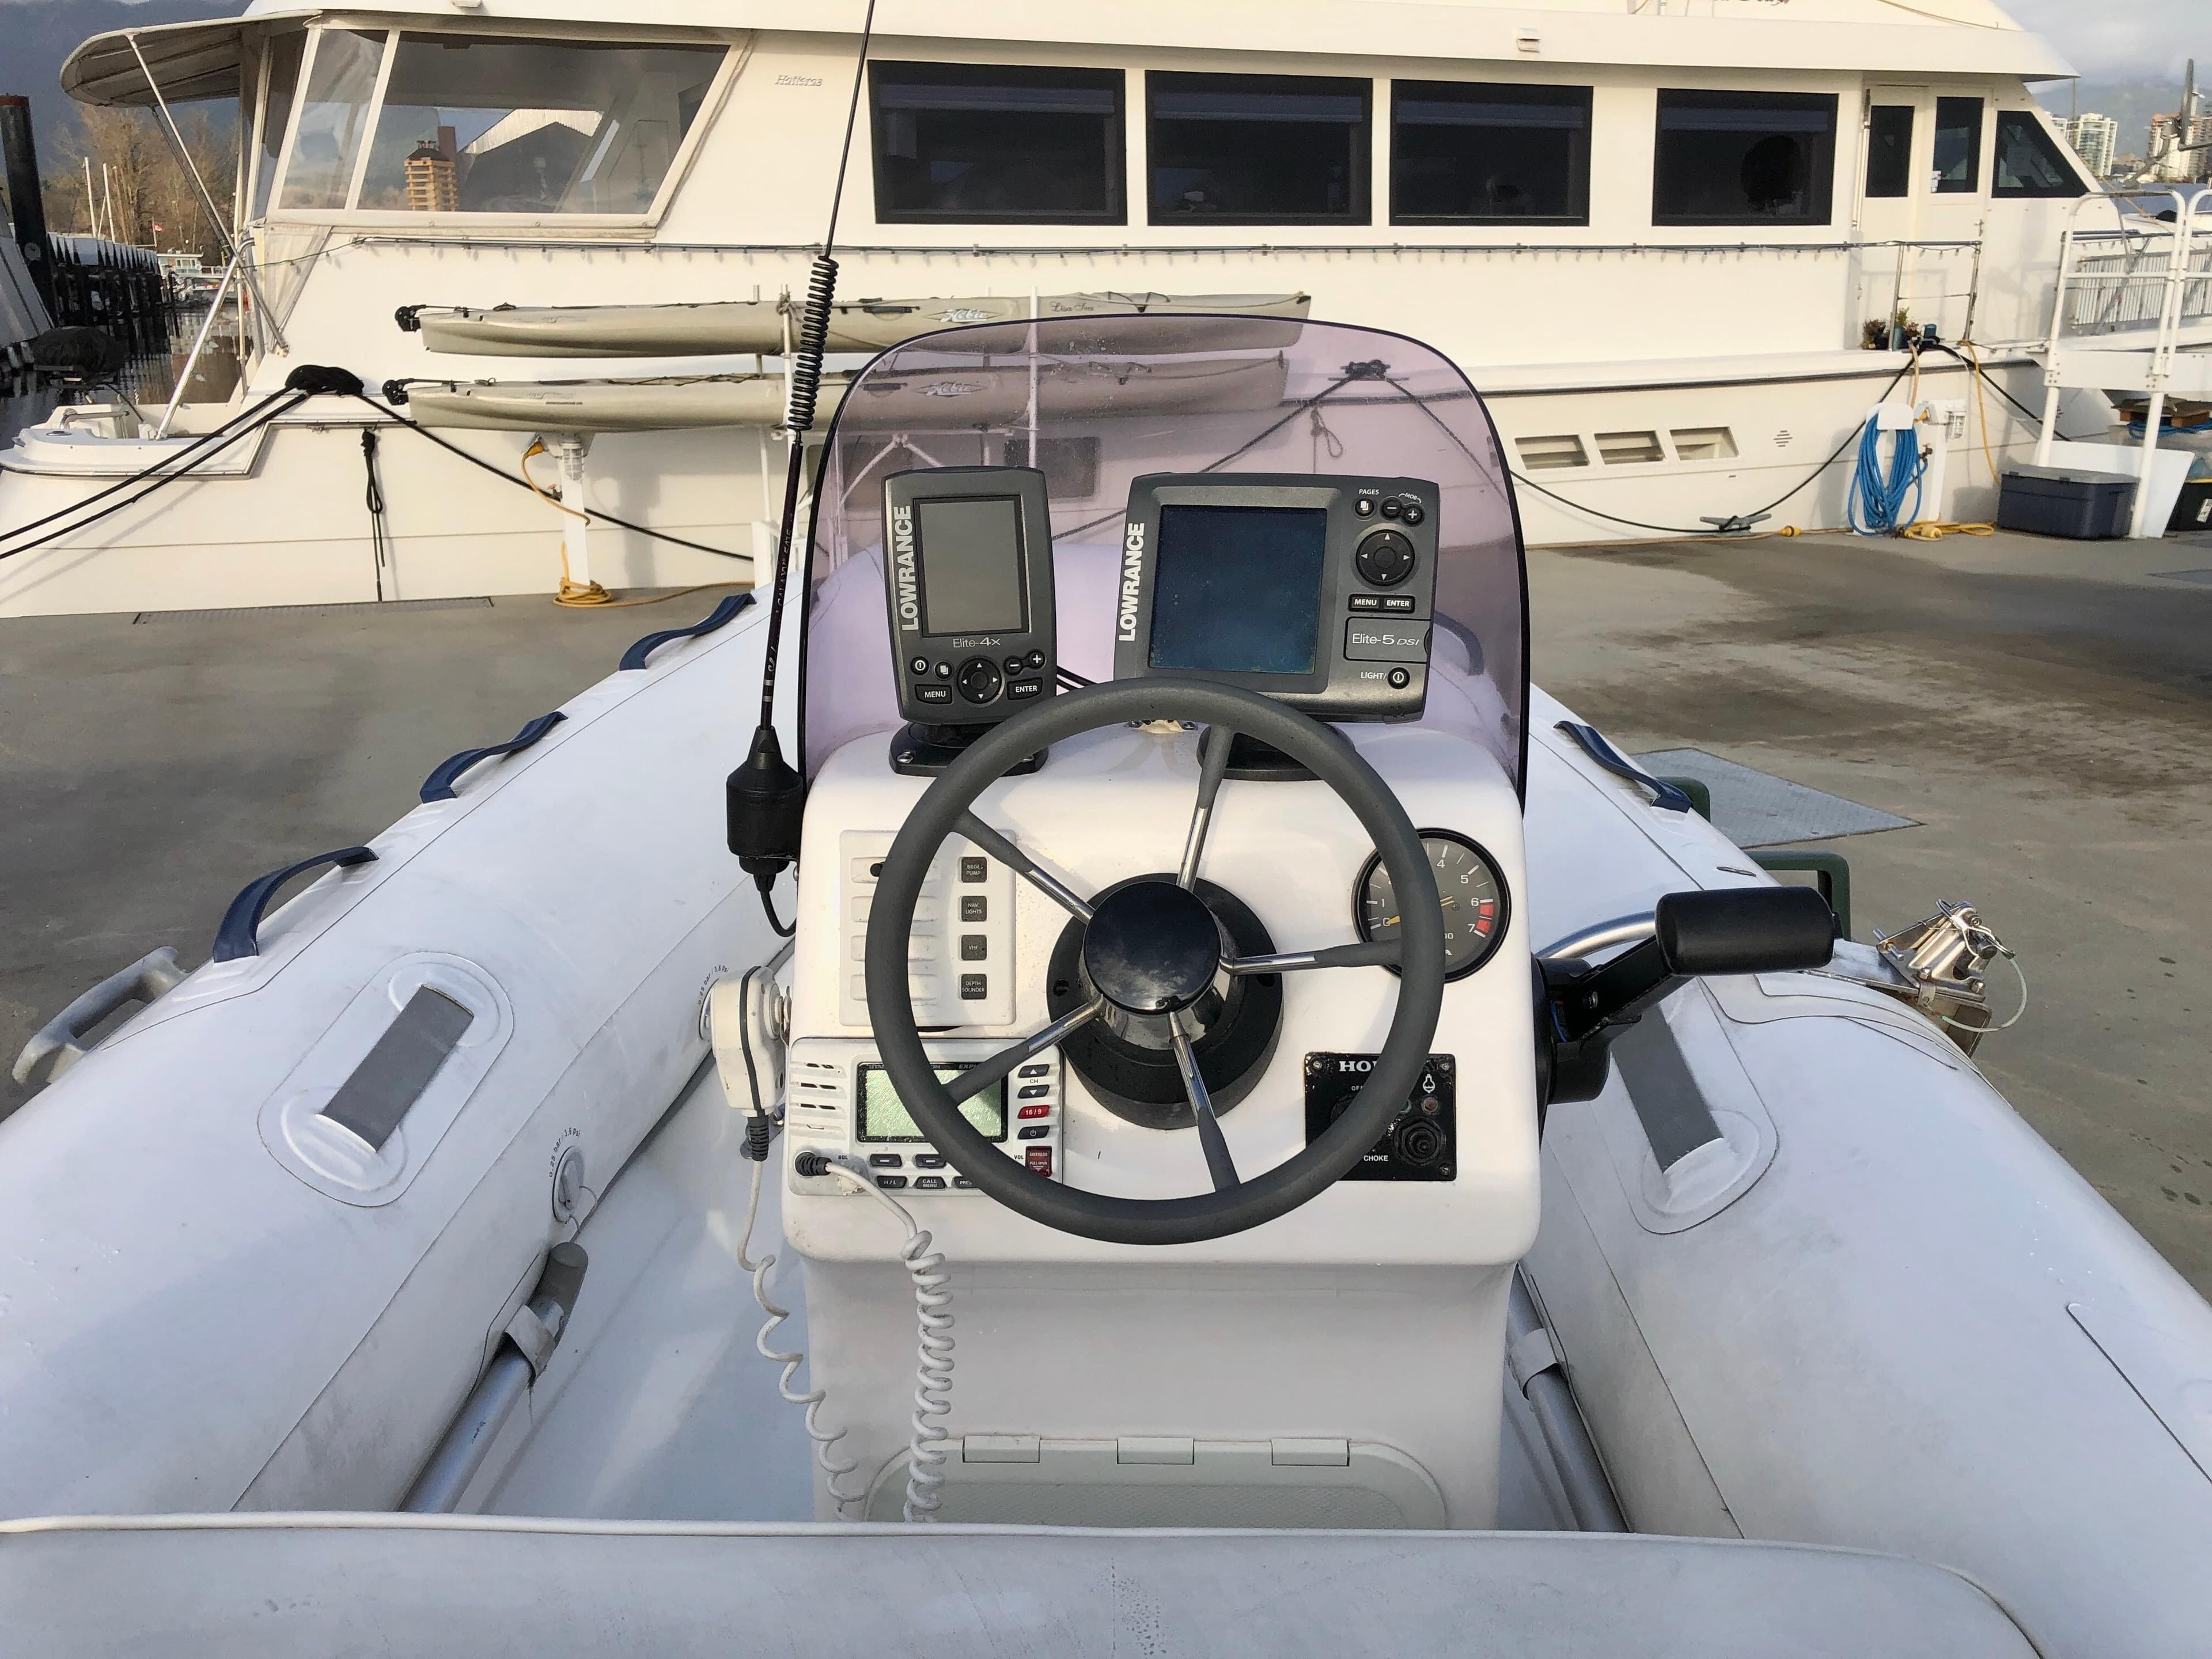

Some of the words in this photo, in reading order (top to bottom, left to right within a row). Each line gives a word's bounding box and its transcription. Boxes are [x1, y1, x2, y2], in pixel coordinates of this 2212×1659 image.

[893, 505, 919, 631] LOWRANCE
[1118, 522, 1145, 641] LOWRANCE
[953, 637, 1001, 648] Elite-4x
[1353, 633, 1395, 645] Elite-5
[1015, 684, 1037, 694] ENTER
[925, 690, 946, 699] MENU
[1437, 859, 1446, 868] 4
[1460, 875, 1468, 884] 5
[1380, 899, 1385, 908] 1
[1471, 898, 1479, 906] 6
[1468, 923, 1475, 933] 7
[553, 1138, 562, 1153] bar
